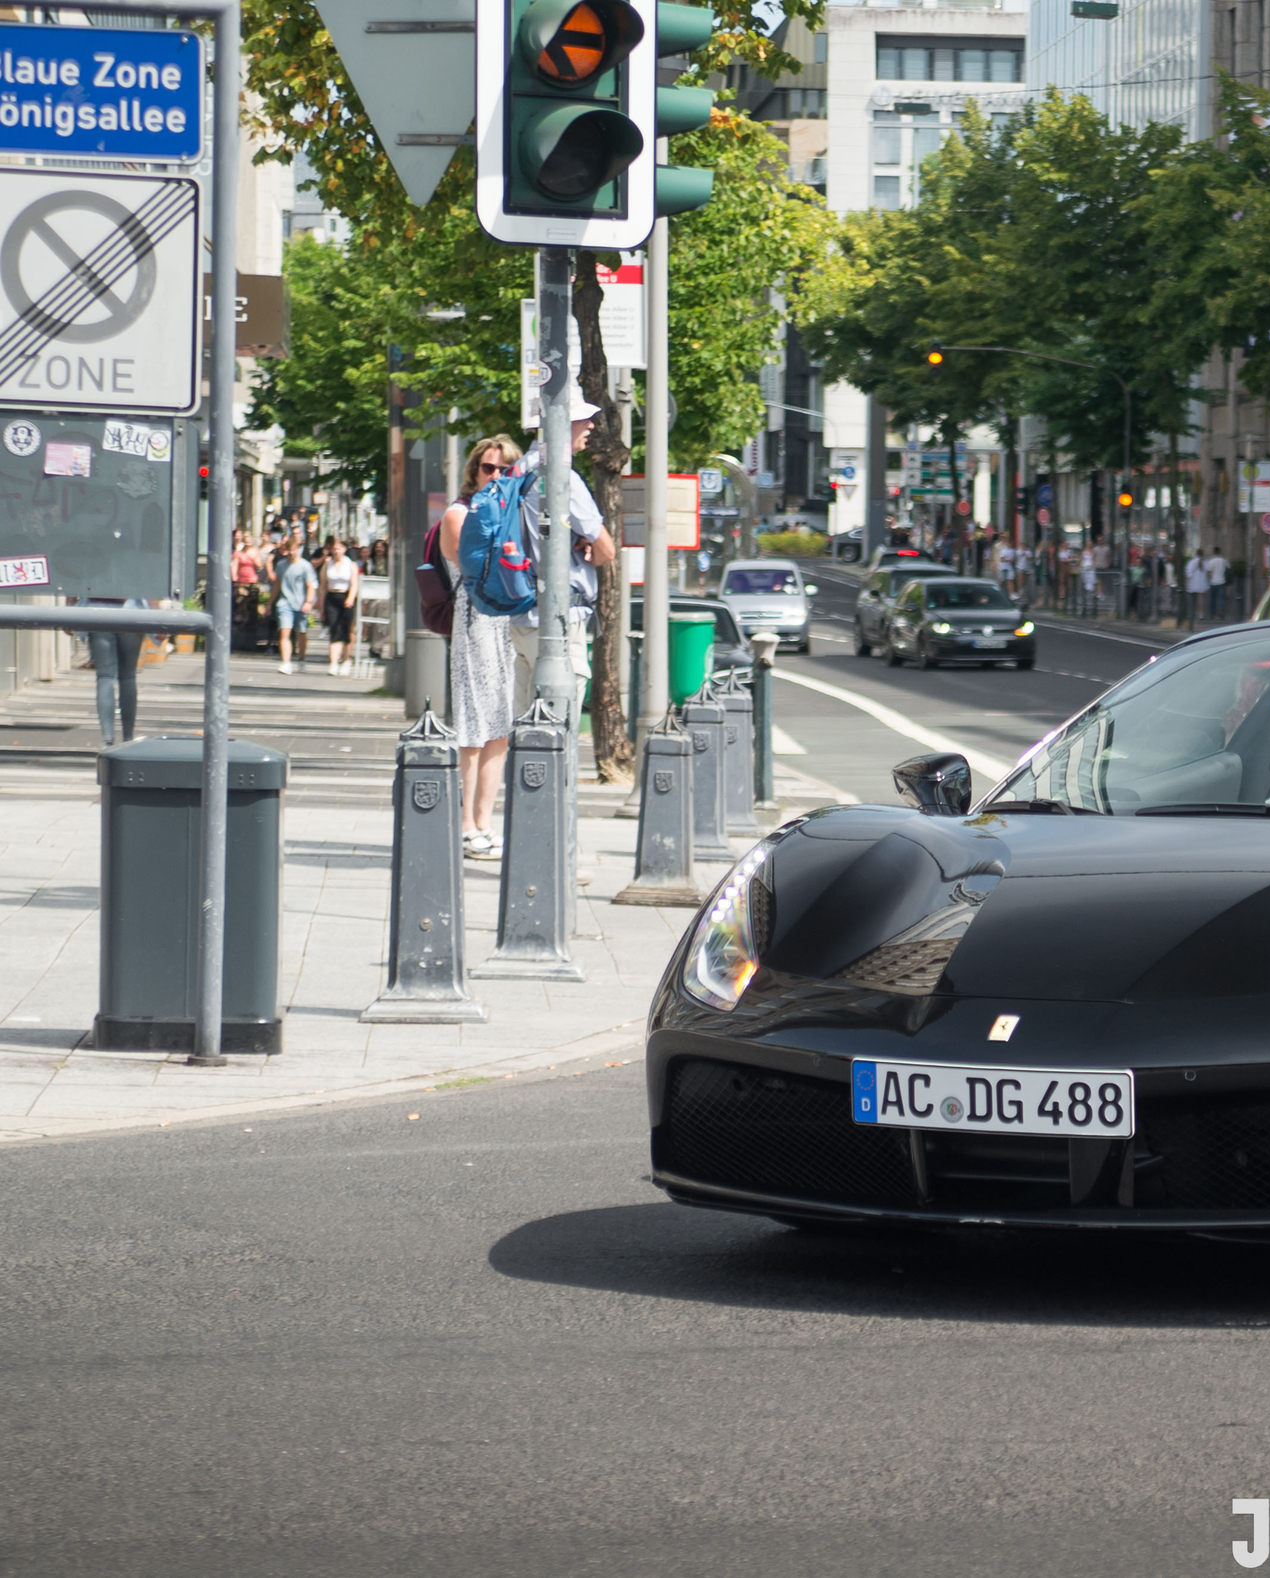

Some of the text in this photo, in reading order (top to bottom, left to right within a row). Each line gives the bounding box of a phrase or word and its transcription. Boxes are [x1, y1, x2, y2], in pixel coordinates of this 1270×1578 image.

[0, 50, 182, 90] laue Zone
[0, 94, 186, 137] önigsallee
[19, 355, 136, 394] ZONE
[861, 1097, 871, 1112] D
[881, 1071, 1124, 1128] AC DG 488
